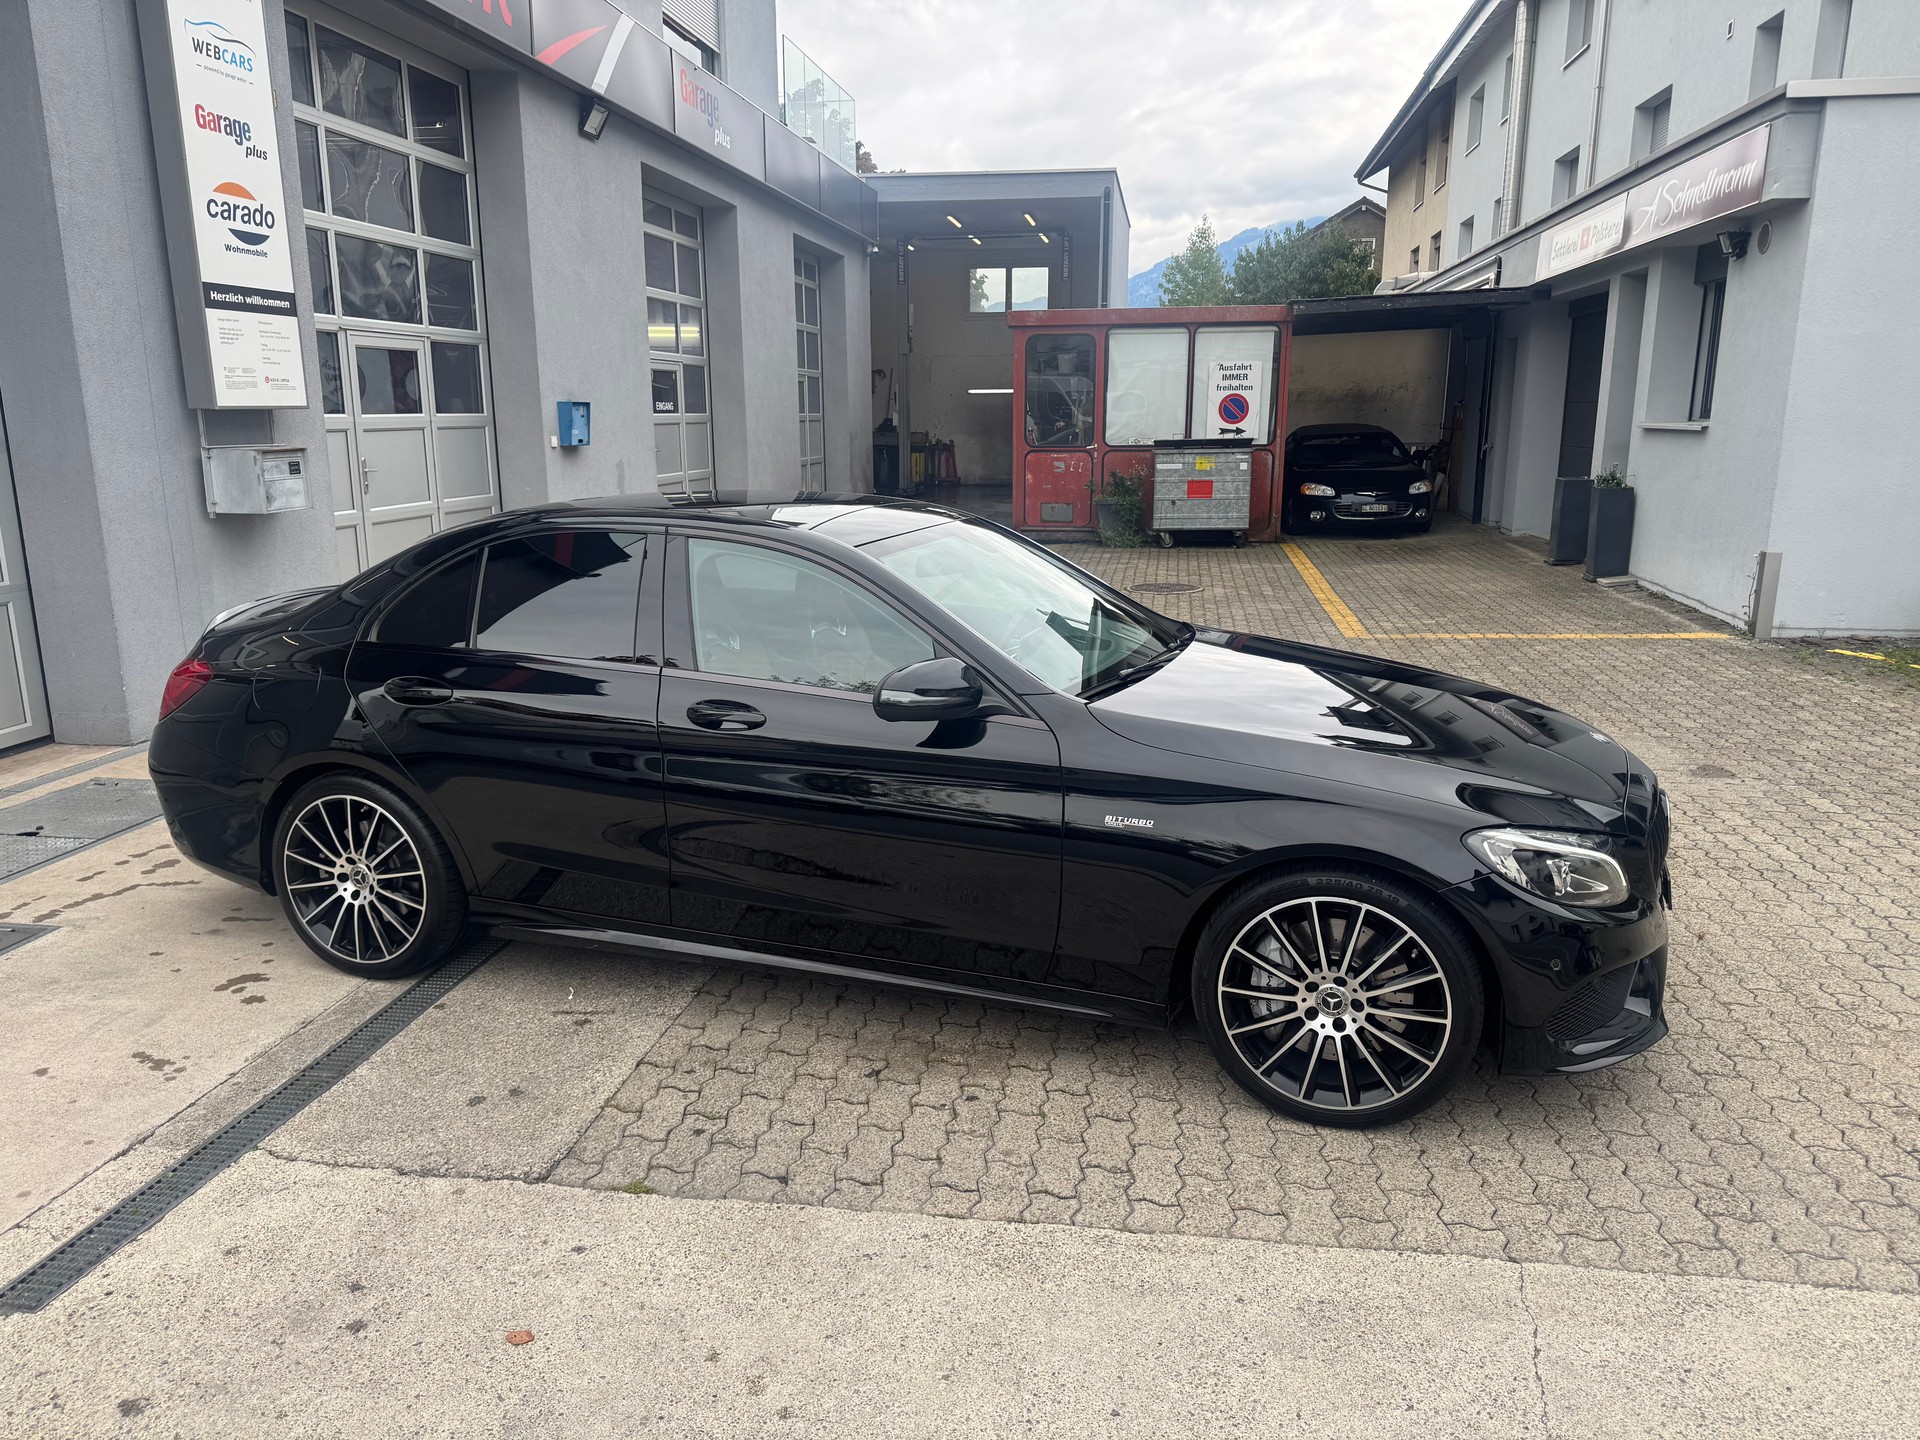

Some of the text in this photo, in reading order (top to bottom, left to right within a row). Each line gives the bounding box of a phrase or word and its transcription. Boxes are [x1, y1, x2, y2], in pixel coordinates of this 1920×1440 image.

[191, 36, 254, 72] WEBCARS
[680, 67, 720, 128] Garage
[194, 103, 252, 146] Garage
[714, 127, 731, 149] plus
[245, 145, 268, 161] plus
[206, 198, 276, 229] carado
[224, 243, 269, 258] Wohnmobile
[210, 290, 291, 308] Herzlich willkommen
[1218, 363, 1252, 371] Ausfahrt
[1221, 373, 1249, 381] IMMER
[1215, 383, 1254, 391] freihalten
[655, 401, 674, 411] EINGANG
[1105, 815, 1154, 827] BITURBO
[1315, 878, 1363, 889] 225/40
